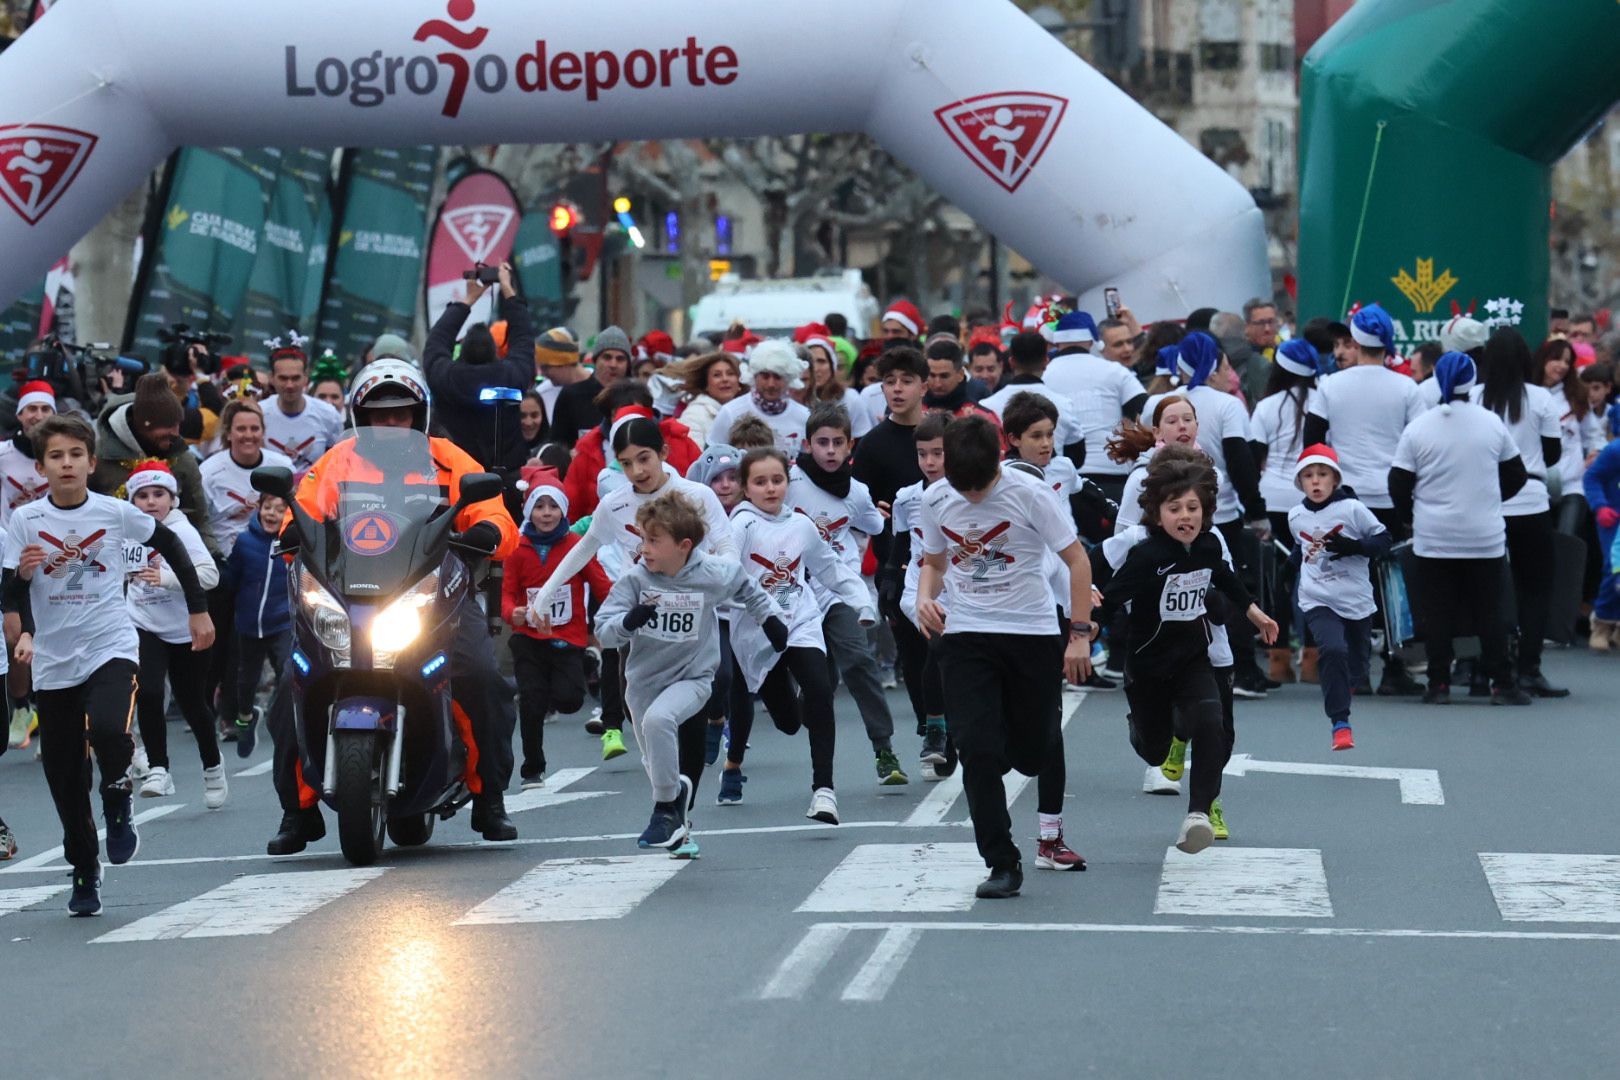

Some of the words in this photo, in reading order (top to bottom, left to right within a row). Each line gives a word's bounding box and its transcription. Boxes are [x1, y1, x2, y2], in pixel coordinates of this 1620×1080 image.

[285, 8, 508, 118] Logroño
[515, 37, 739, 101] deporte
[122, 546, 143, 563] 149
